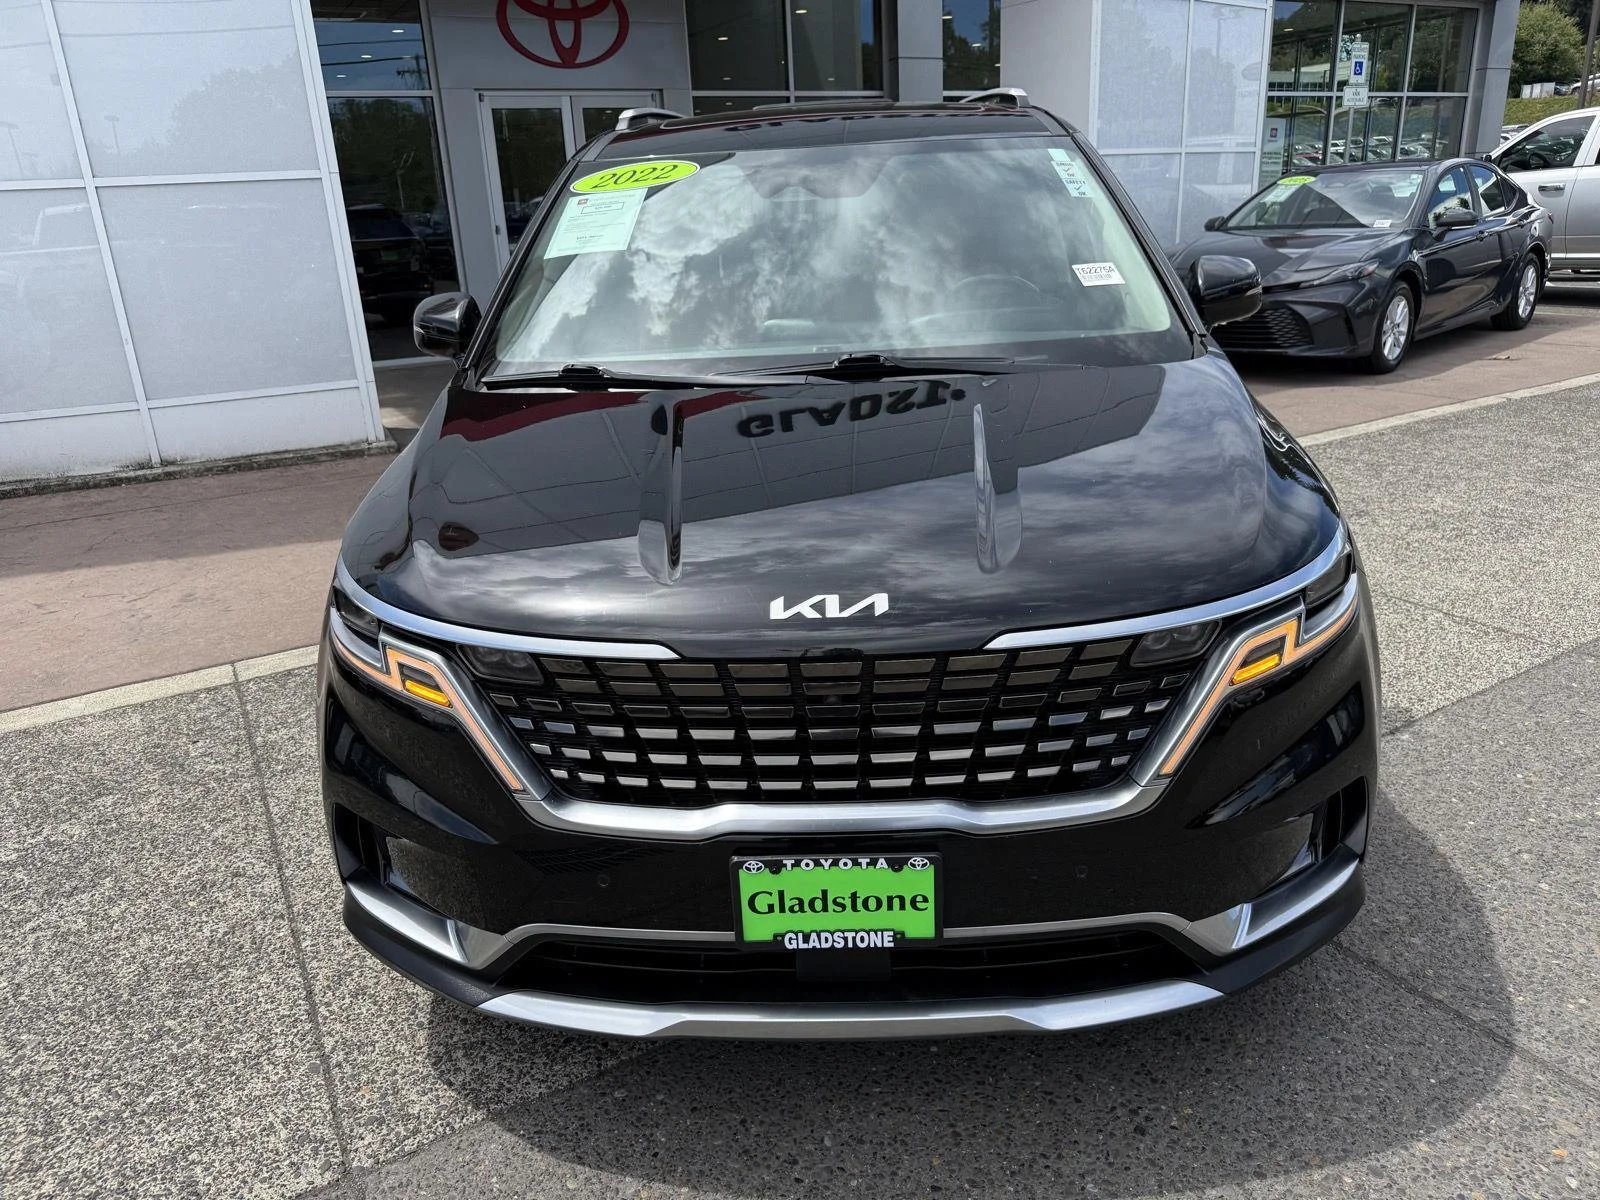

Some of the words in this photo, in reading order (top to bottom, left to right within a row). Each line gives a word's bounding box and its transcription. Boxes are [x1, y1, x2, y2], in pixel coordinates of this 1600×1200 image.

[590, 164, 678, 190] 2022
[1074, 265, 1116, 276] T62275A
[769, 592, 889, 620] KIA
[783, 857, 889, 871] TOYOTA
[747, 888, 930, 915] Gladstone
[784, 930, 895, 949] GLADSTONE
